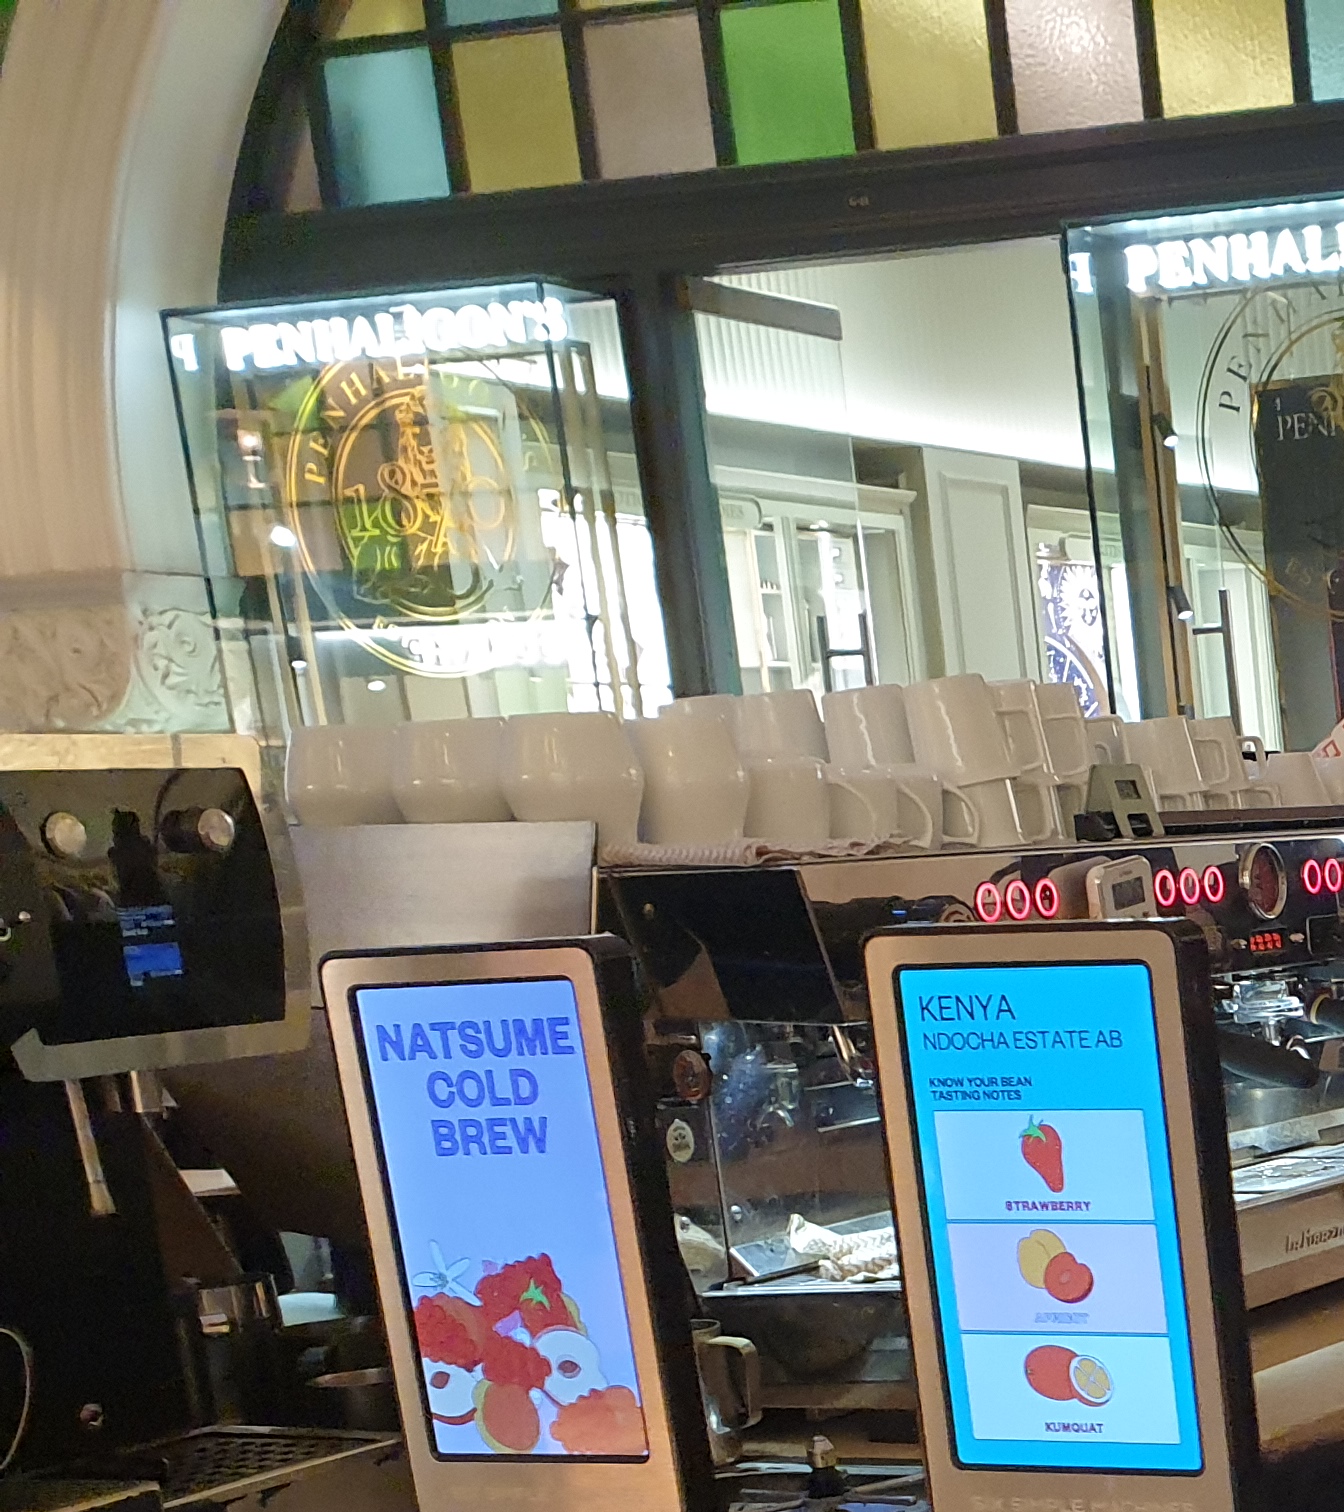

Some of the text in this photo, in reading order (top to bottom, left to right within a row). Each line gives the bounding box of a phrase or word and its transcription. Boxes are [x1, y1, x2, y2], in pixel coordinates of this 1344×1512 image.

[918, 994, 1017, 1022] KENYA
[376, 1017, 577, 1062] NATSUME
[923, 1029, 1124, 1051] NDOCHA ESTATE AB
[426, 1068, 539, 1109] COLD
[928, 1076, 1033, 1088] KNOW YOUR BEAN
[930, 1089, 1022, 1101] TASTING NOTES
[430, 1116, 549, 1157] BREW
[1005, 1200, 1091, 1212] STRAWBERRY
[1045, 1421, 1104, 1434] KUMQUAT
